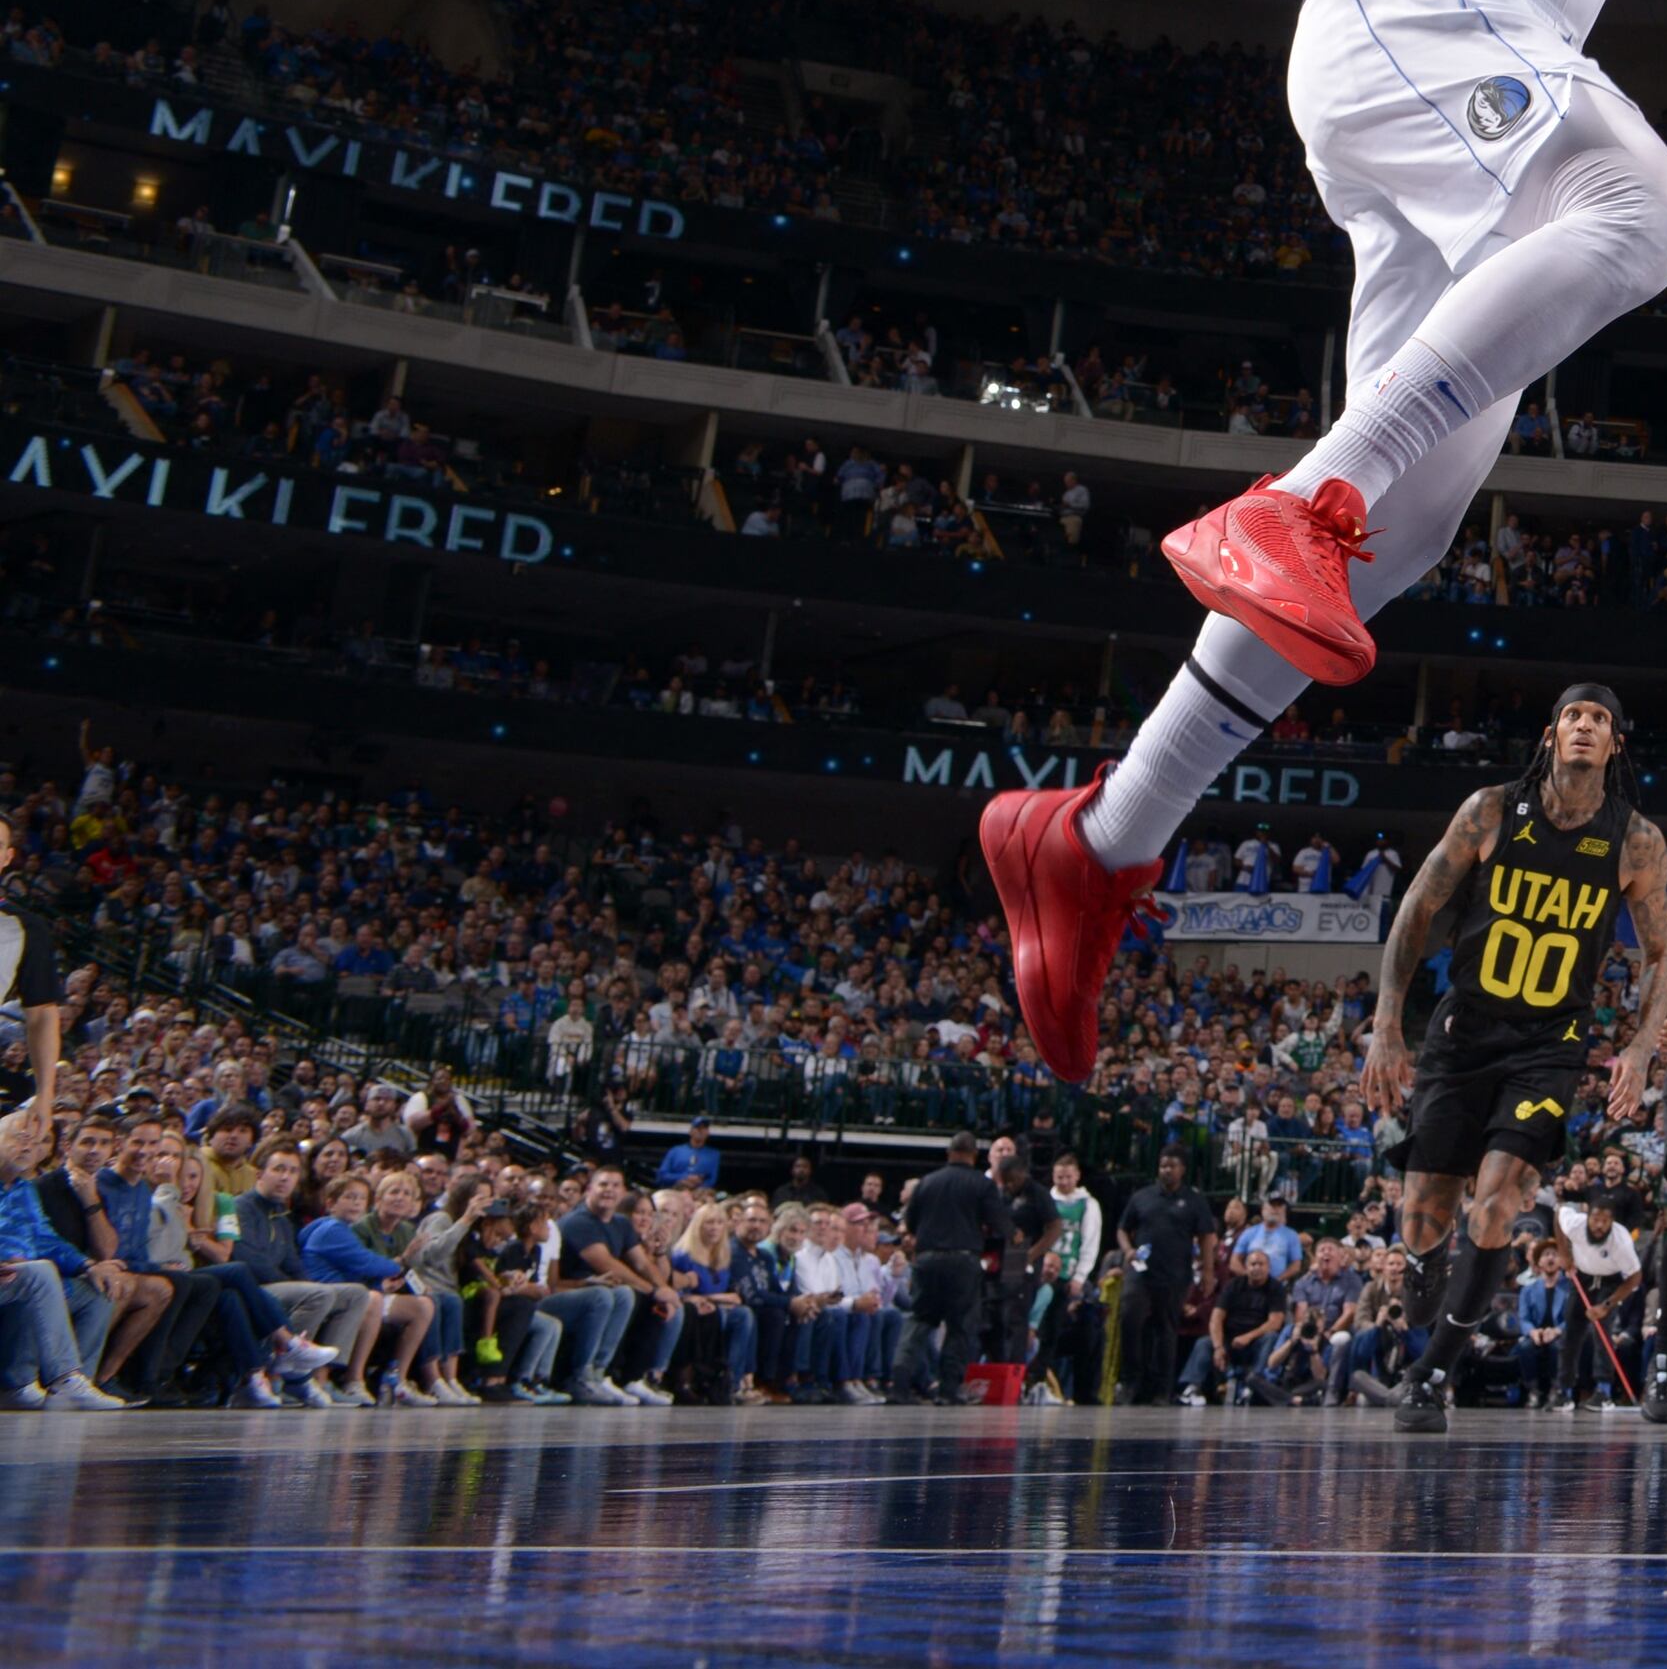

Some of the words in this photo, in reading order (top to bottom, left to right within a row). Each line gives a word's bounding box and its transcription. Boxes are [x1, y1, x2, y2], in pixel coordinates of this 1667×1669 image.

[1516, 802, 1529, 816] 6
[1489, 864, 1609, 930] UTAH
[1318, 912, 1370, 932] EVO
[1479, 918, 1580, 1008] 00
